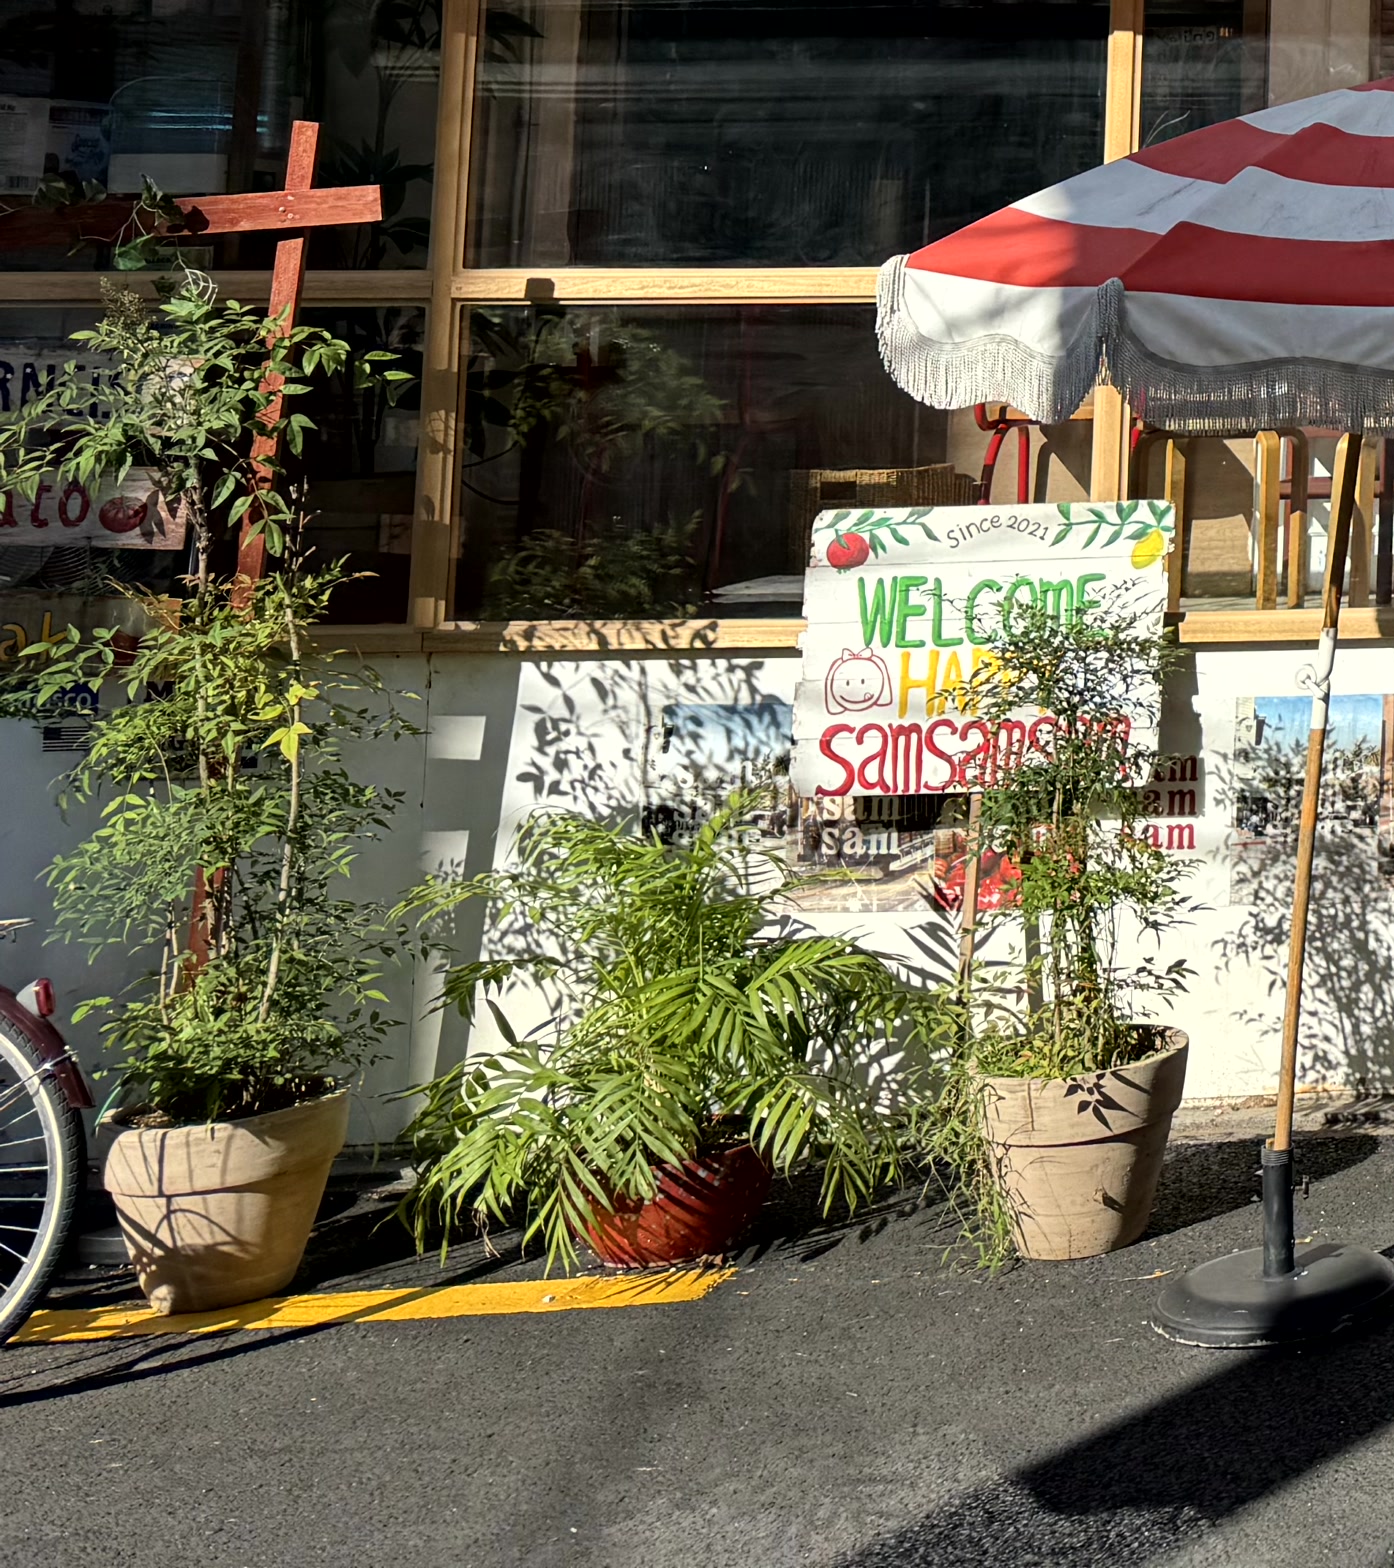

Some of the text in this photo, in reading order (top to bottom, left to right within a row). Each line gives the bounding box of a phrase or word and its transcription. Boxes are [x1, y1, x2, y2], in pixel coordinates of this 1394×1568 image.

[947, 514, 1050, 548] since 2021
[857, 572, 1110, 649] WELCOME
[821, 823, 900, 855] sam
